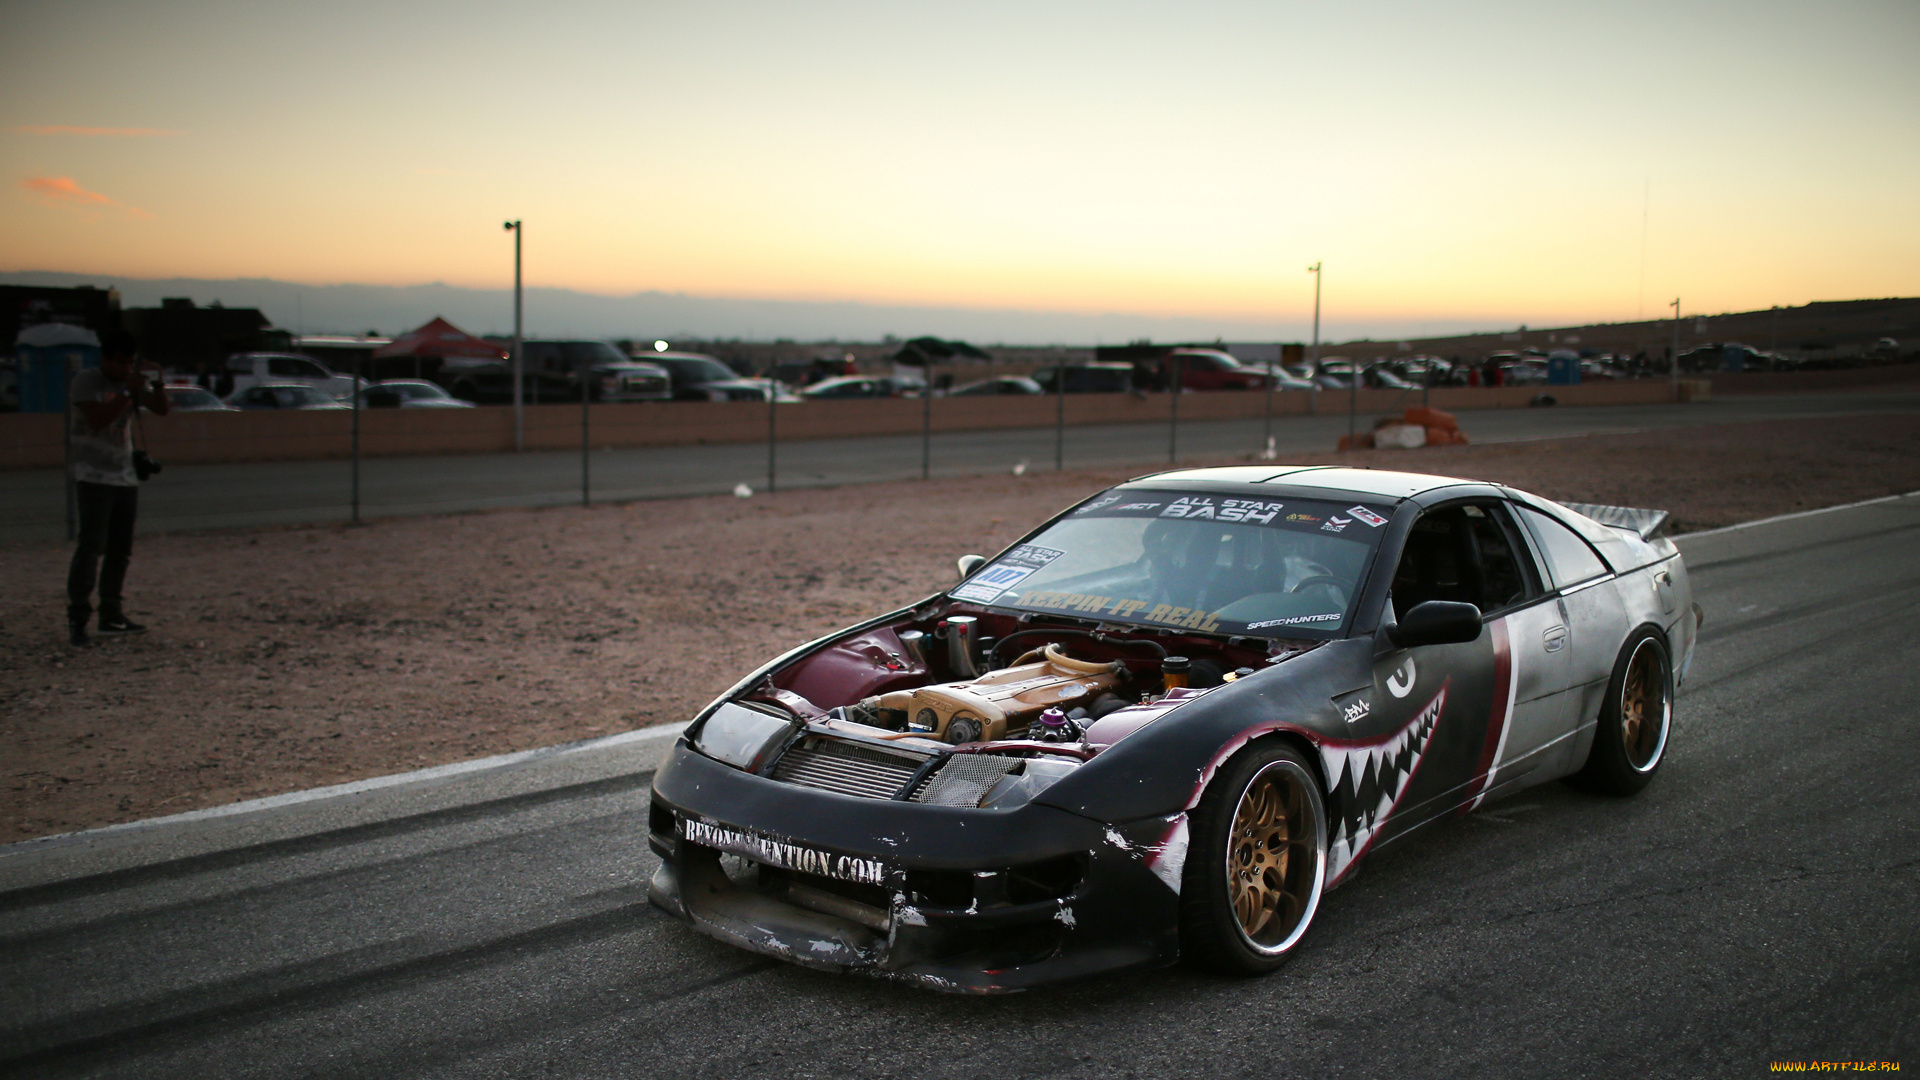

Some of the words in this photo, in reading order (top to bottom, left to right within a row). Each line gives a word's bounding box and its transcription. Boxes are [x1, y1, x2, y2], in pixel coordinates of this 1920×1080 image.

[1172, 497, 1214, 507] ALL
[1221, 499, 1284, 512] STAR
[1159, 504, 1279, 525] BASH
[1007, 550, 1055, 562] BASH
[1018, 545, 1033, 553] ALL
[1034, 547, 1062, 557] STAR
[976, 567, 1027, 585] A07
[1013, 590, 1114, 613] KEEPIN
[1107, 598, 1148, 618] IT
[1144, 603, 1221, 633] REAL
[1246, 613, 1342, 630] SPEEDHUNTERS
